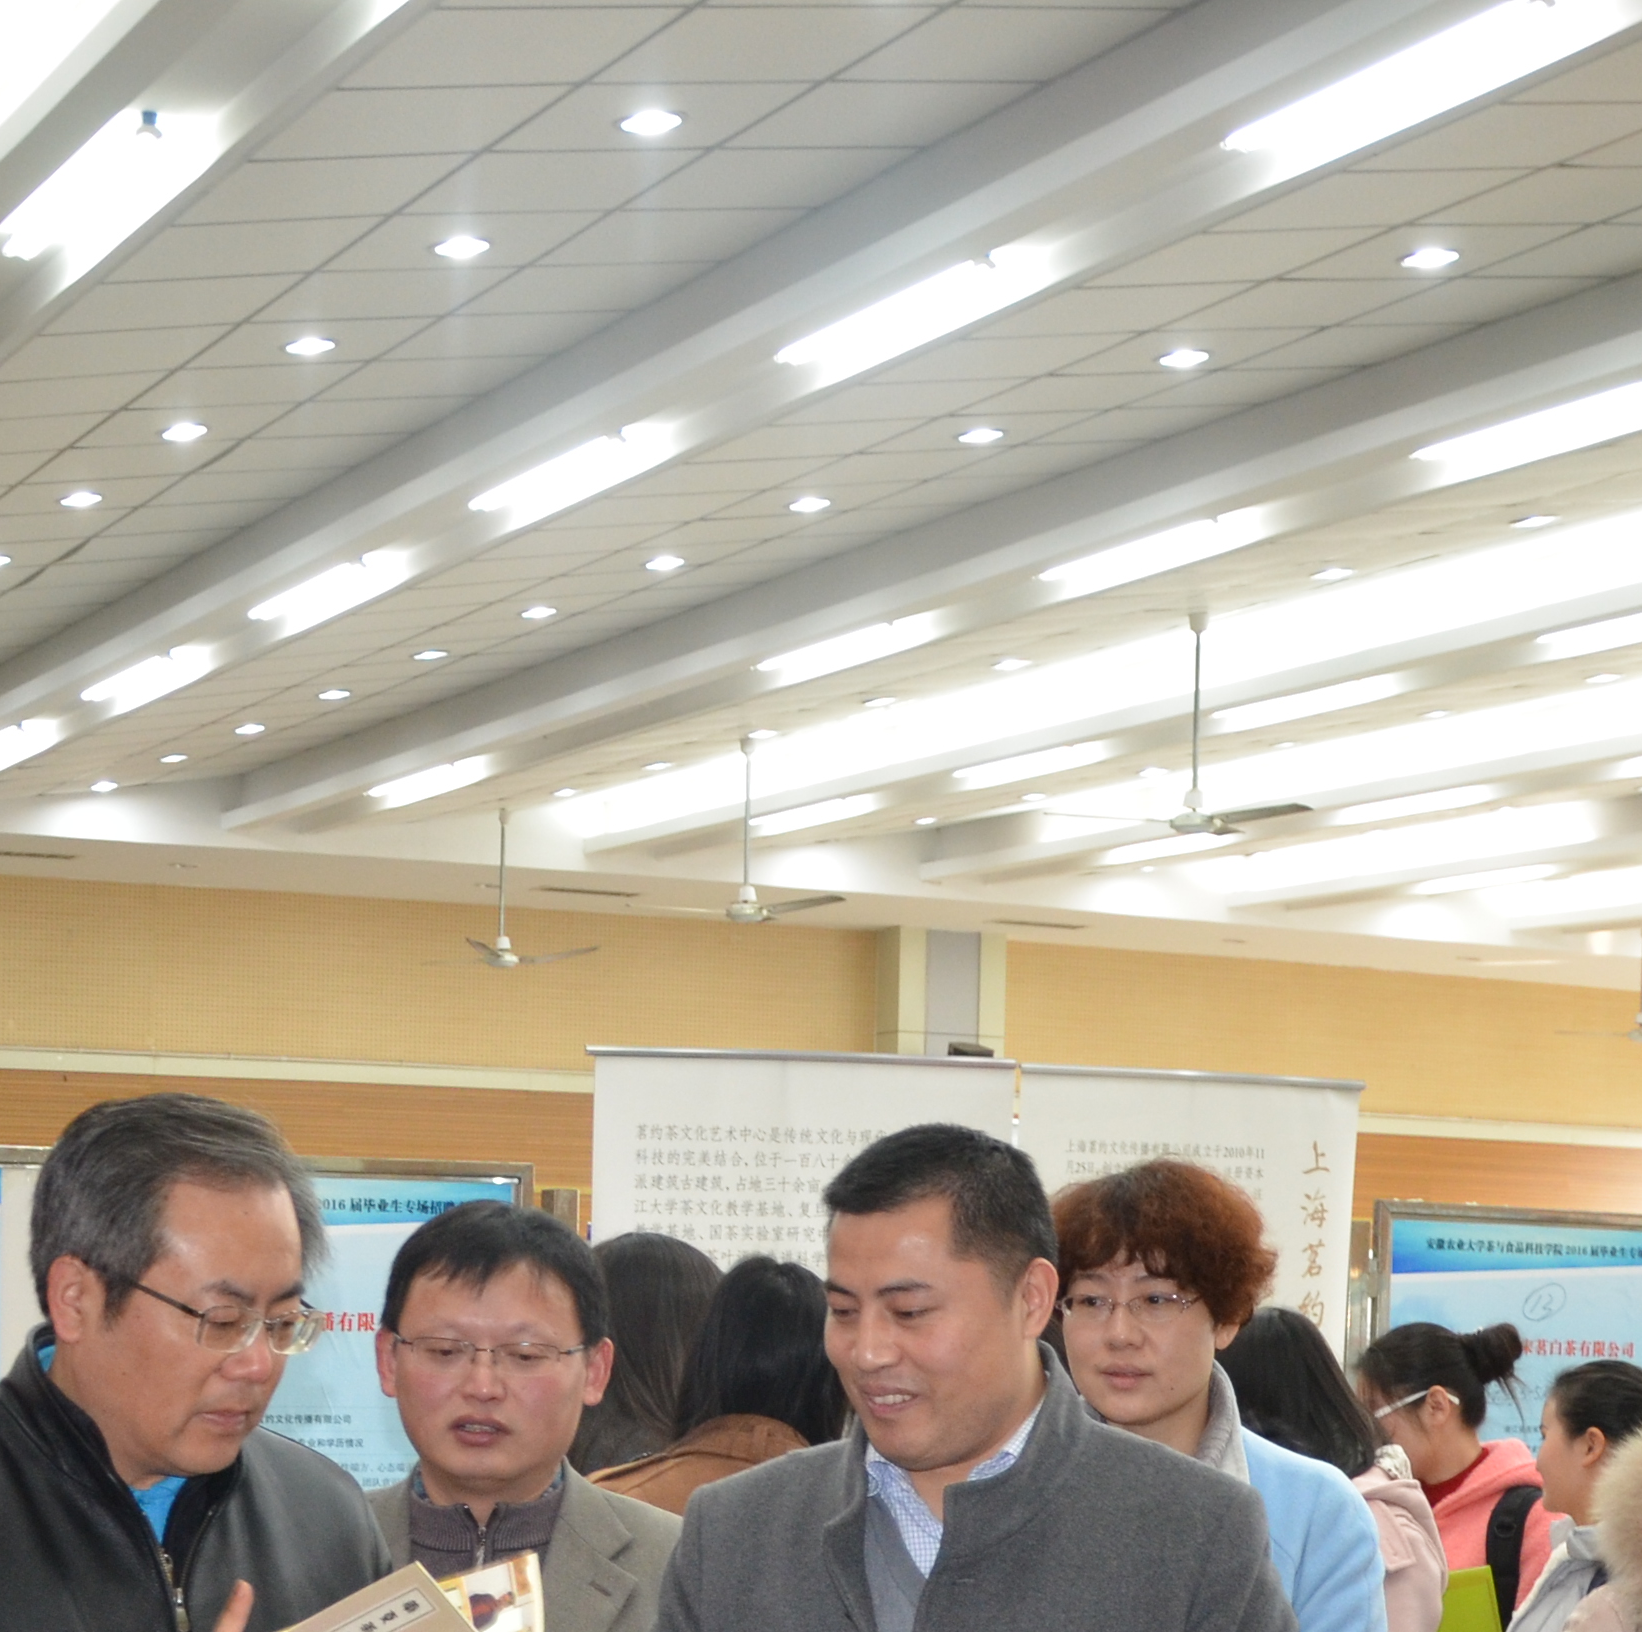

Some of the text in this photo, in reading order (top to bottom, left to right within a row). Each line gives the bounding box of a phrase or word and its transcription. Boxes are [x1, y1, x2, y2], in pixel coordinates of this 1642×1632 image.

[317, 1197, 463, 1215] 016届毕业生专场招聘
[1298, 1140, 1331, 1328] 上海茗约
[260, 1414, 352, 1425] 约文化传播有限公司
